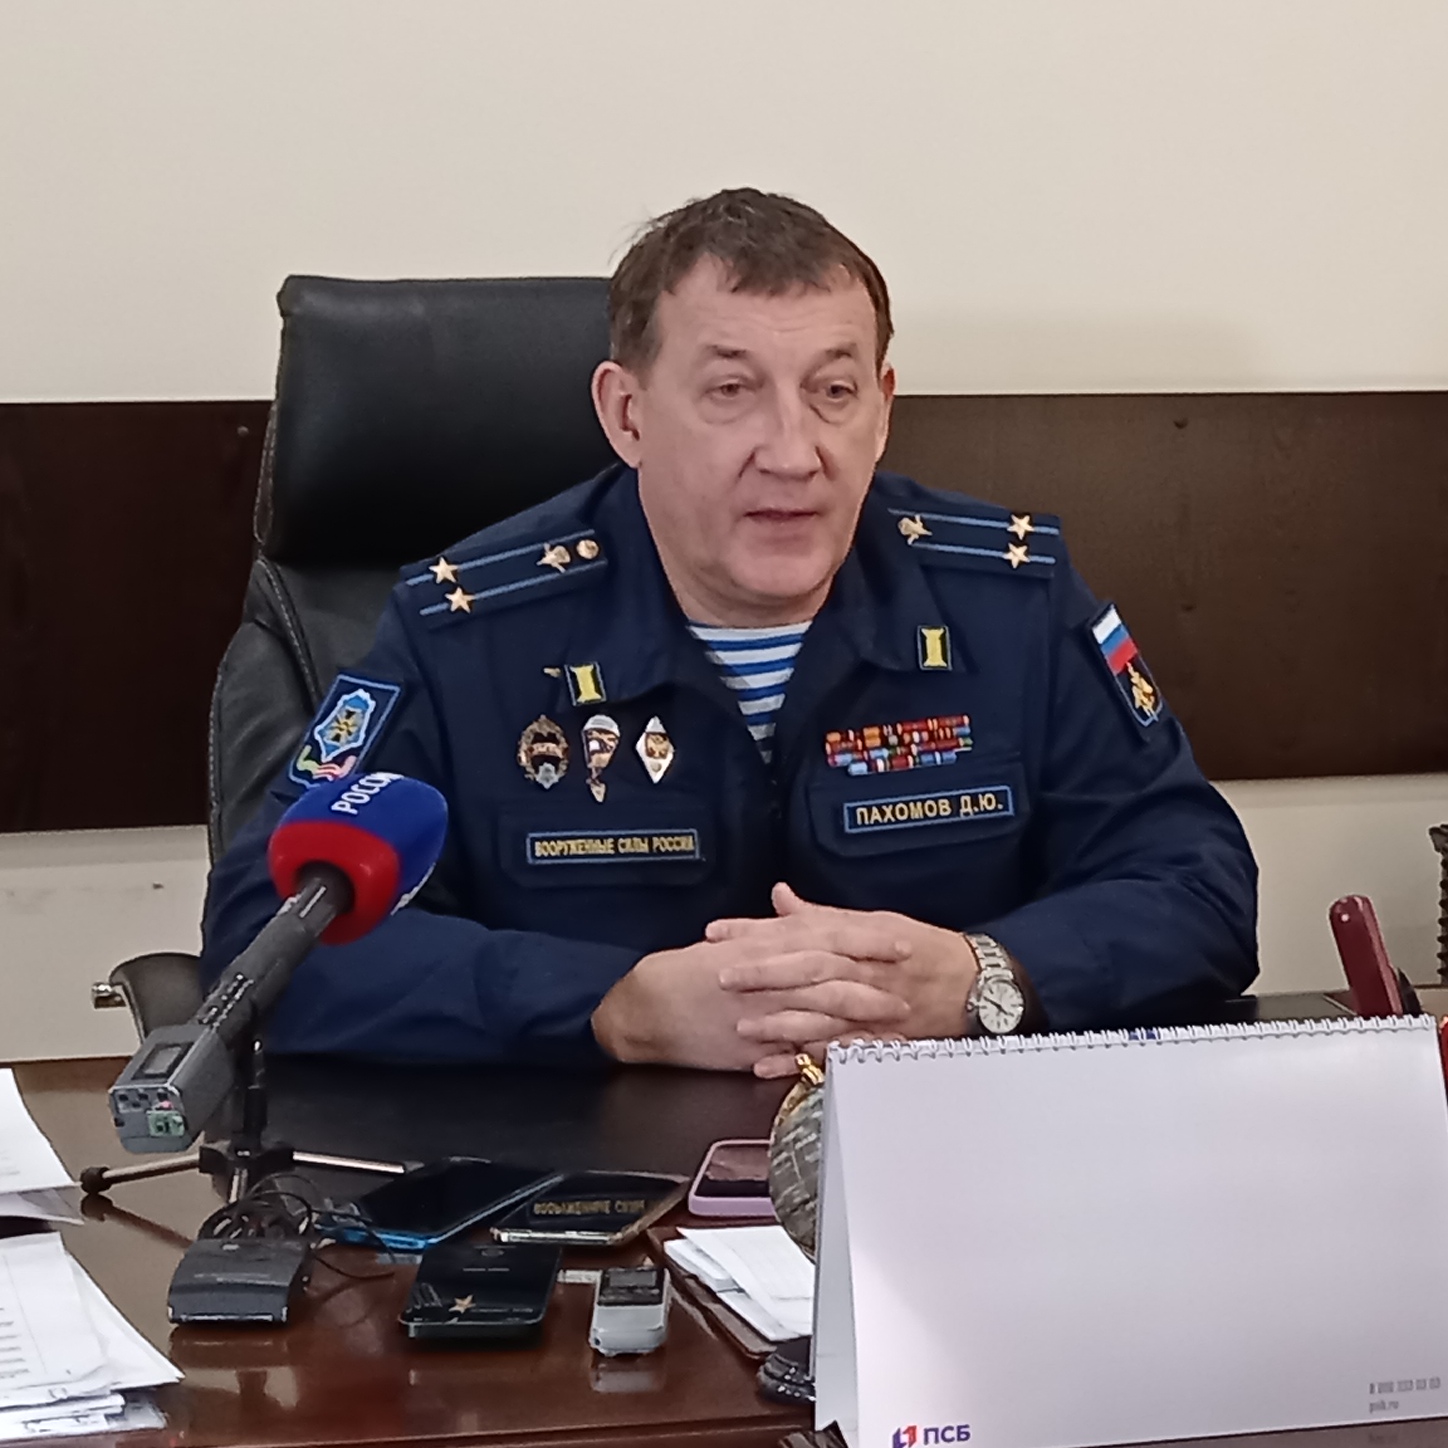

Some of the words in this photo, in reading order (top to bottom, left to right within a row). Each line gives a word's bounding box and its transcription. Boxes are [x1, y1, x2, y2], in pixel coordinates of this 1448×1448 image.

[856, 798, 952, 826] ПАХОМОВ
[959, 793, 1004, 819] Д.Ю.
[923, 1424, 971, 1445] ПСБ
